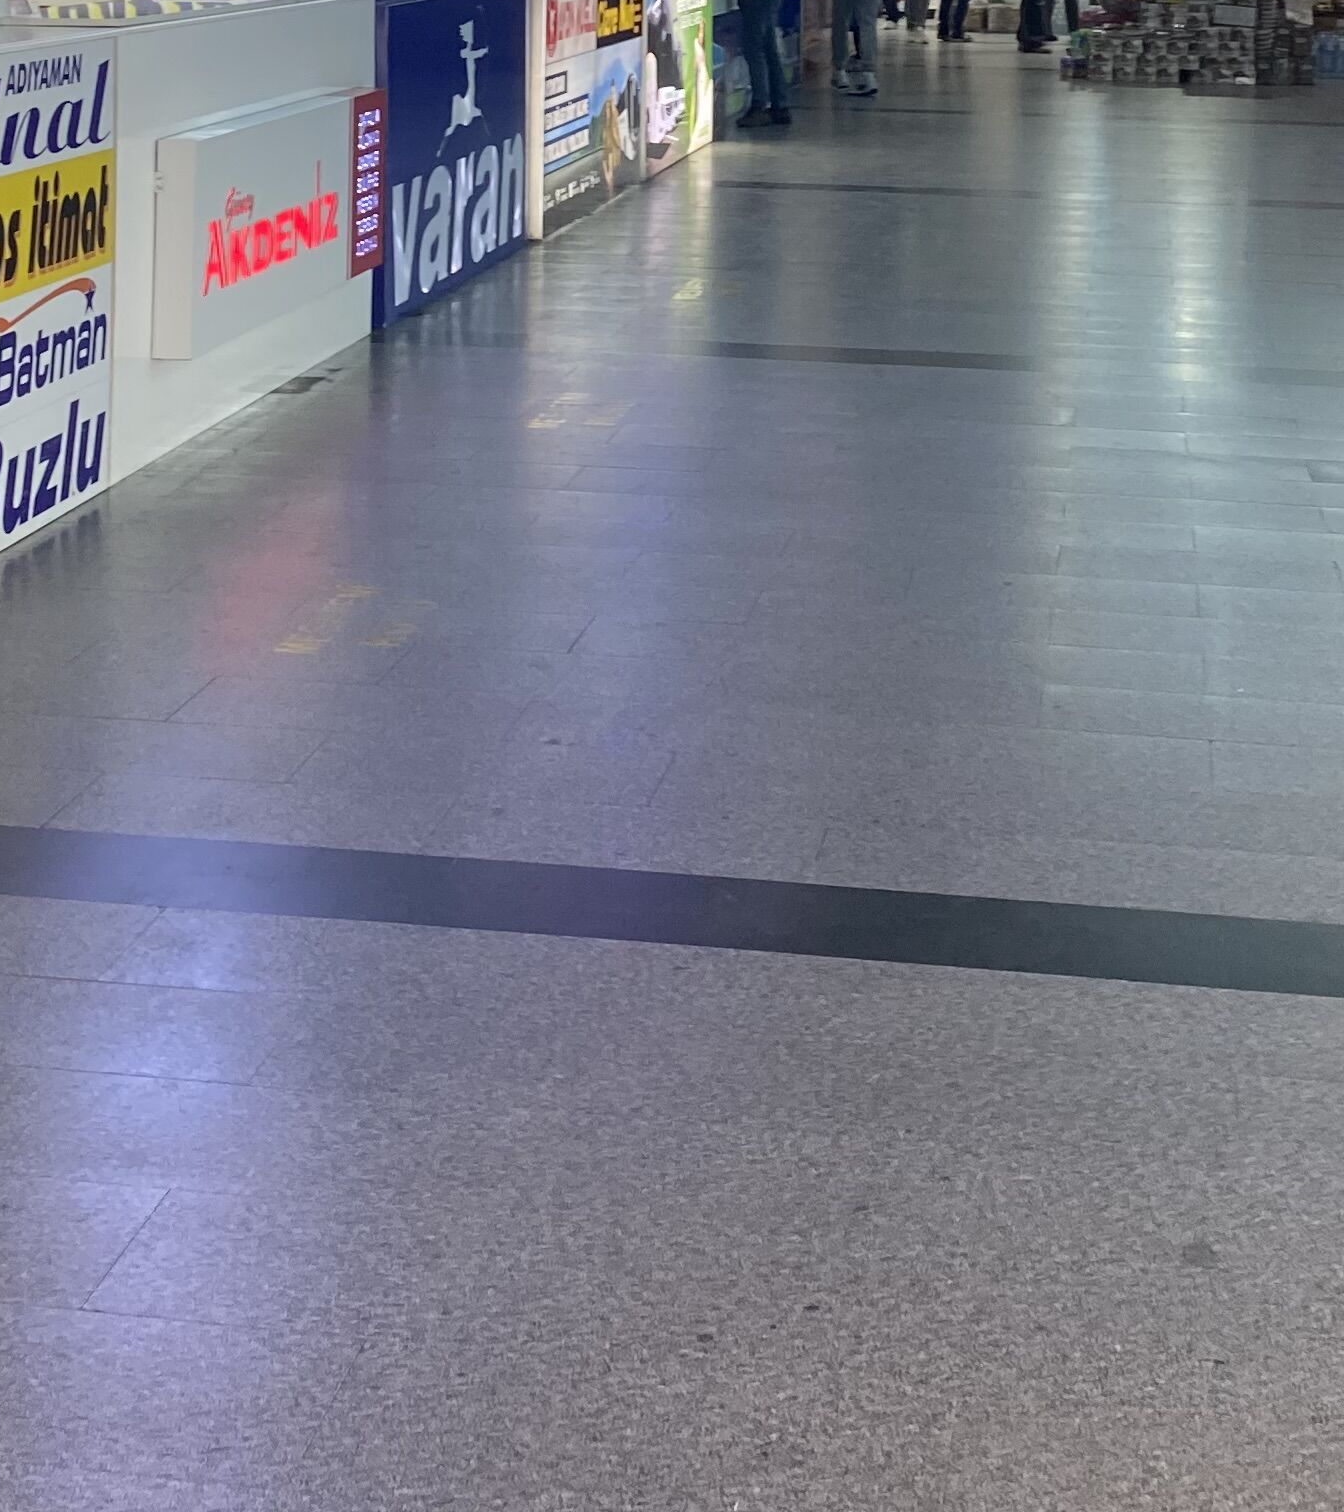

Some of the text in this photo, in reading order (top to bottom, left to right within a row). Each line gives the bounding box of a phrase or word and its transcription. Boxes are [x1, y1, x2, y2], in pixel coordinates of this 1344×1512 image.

[5, 53, 83, 96] ADIYAMAN
[27, 165, 109, 279] itimat
[392, 133, 524, 307] varan
